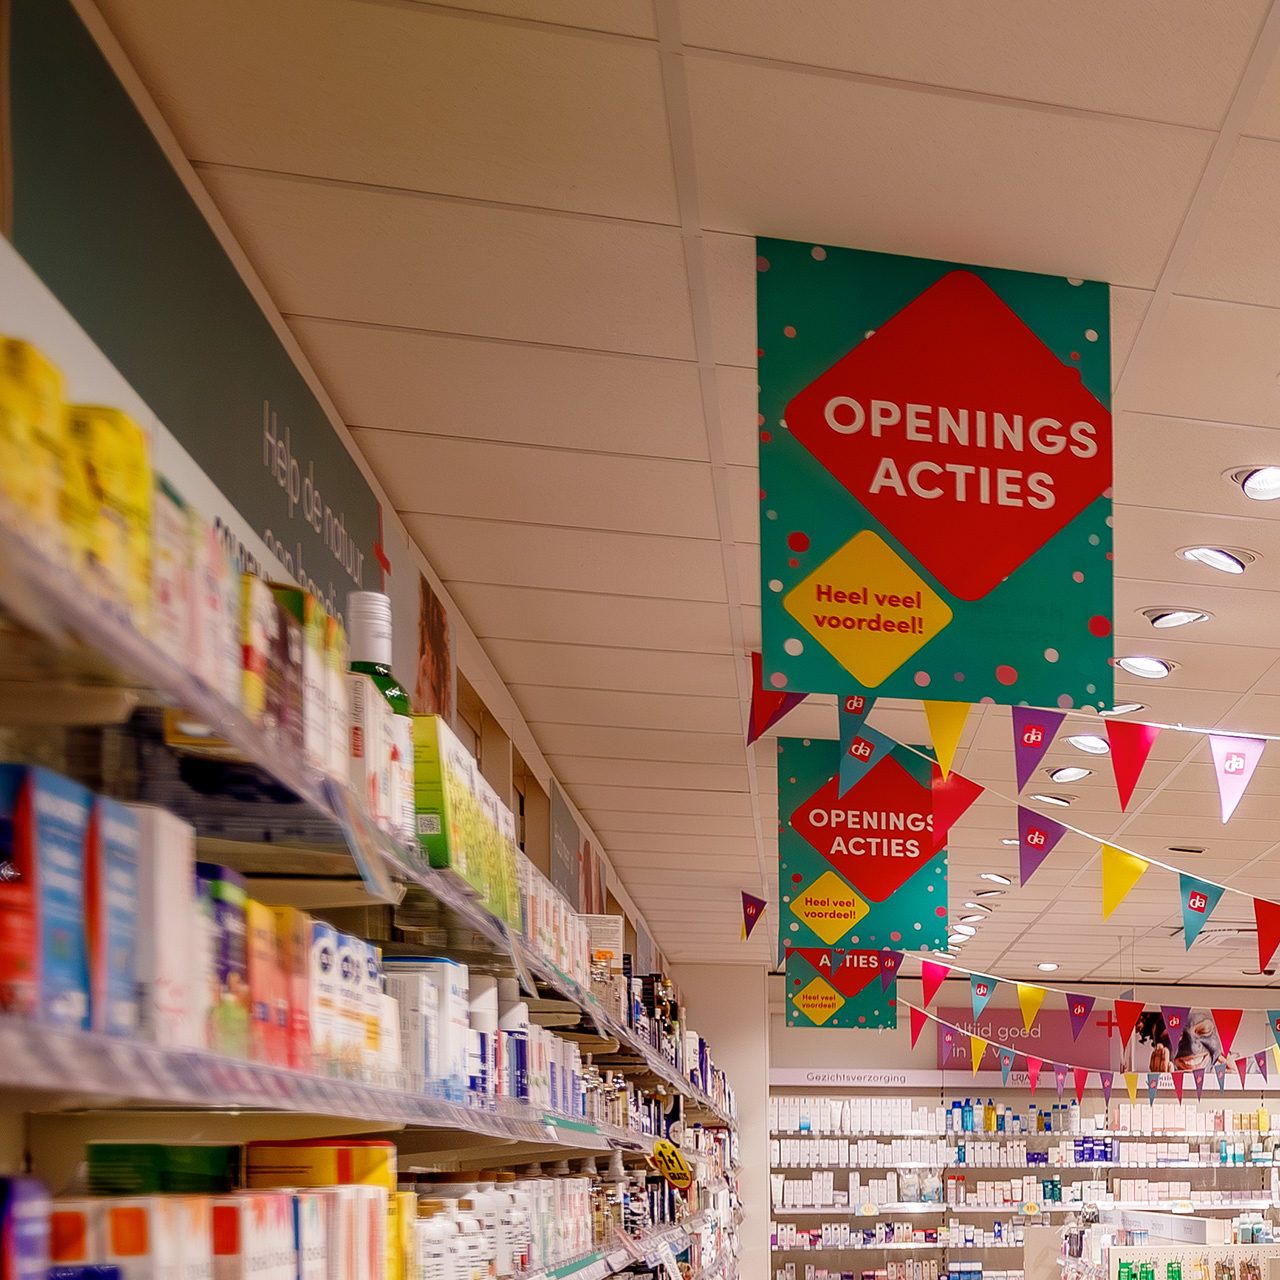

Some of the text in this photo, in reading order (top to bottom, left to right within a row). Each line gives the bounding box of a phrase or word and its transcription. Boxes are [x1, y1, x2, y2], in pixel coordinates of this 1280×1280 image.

[823, 395, 1098, 458] OPENINGS
[868, 457, 1057, 510] ACTIES
[263, 400, 300, 519] Help
[302, 461, 323, 535] de
[323, 504, 365, 589] natuur
[815, 583, 922, 610] Heel veel
[813, 610, 924, 635] voordeel!
[830, 837, 920, 857] ACTIES
[804, 897, 855, 908] Heel veel
[804, 910, 856, 919] voordeel!
[819, 955, 878, 968] ATIES
[997, 1023, 1041, 1043] goed
[806, 1071, 906, 1084] Gezichtsverzorging
